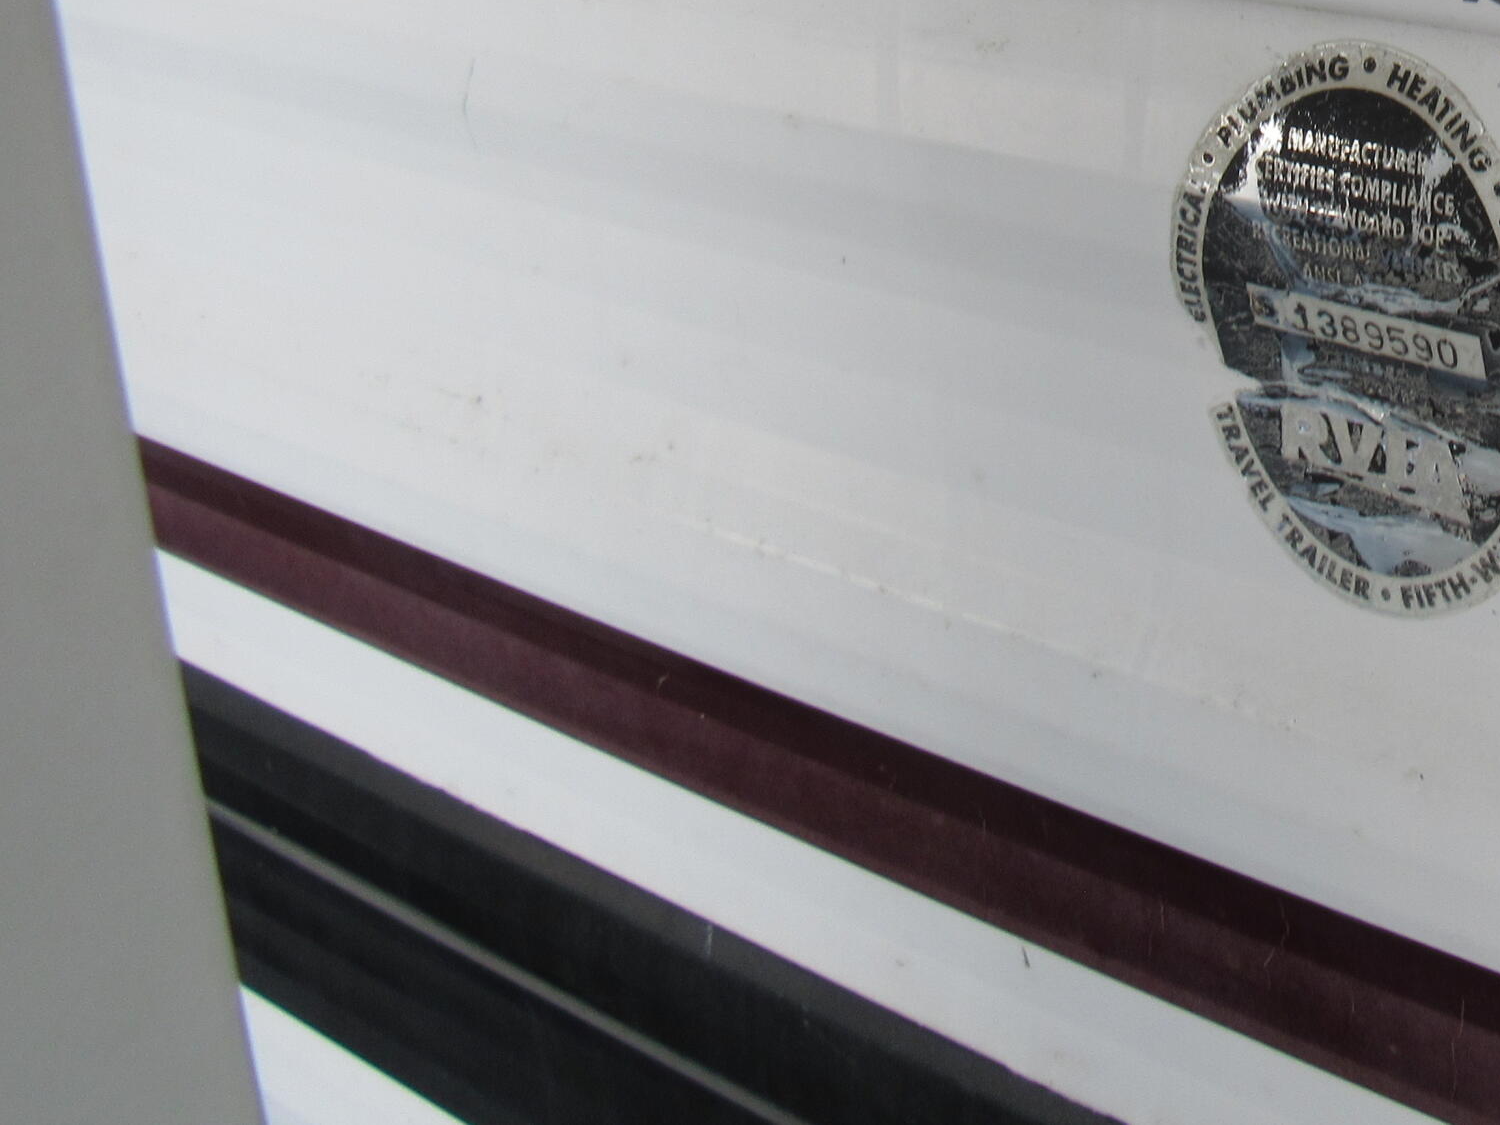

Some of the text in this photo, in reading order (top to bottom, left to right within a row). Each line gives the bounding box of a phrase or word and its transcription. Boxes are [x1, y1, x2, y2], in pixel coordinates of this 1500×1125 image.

[1175, 182, 1208, 323] ELECTRICA
[1386, 63, 1493, 173] HEATING
[1292, 301, 1459, 370] 1389590
[1215, 405, 1278, 513] TRAVEL
[1281, 514, 1371, 601] TRAILER
